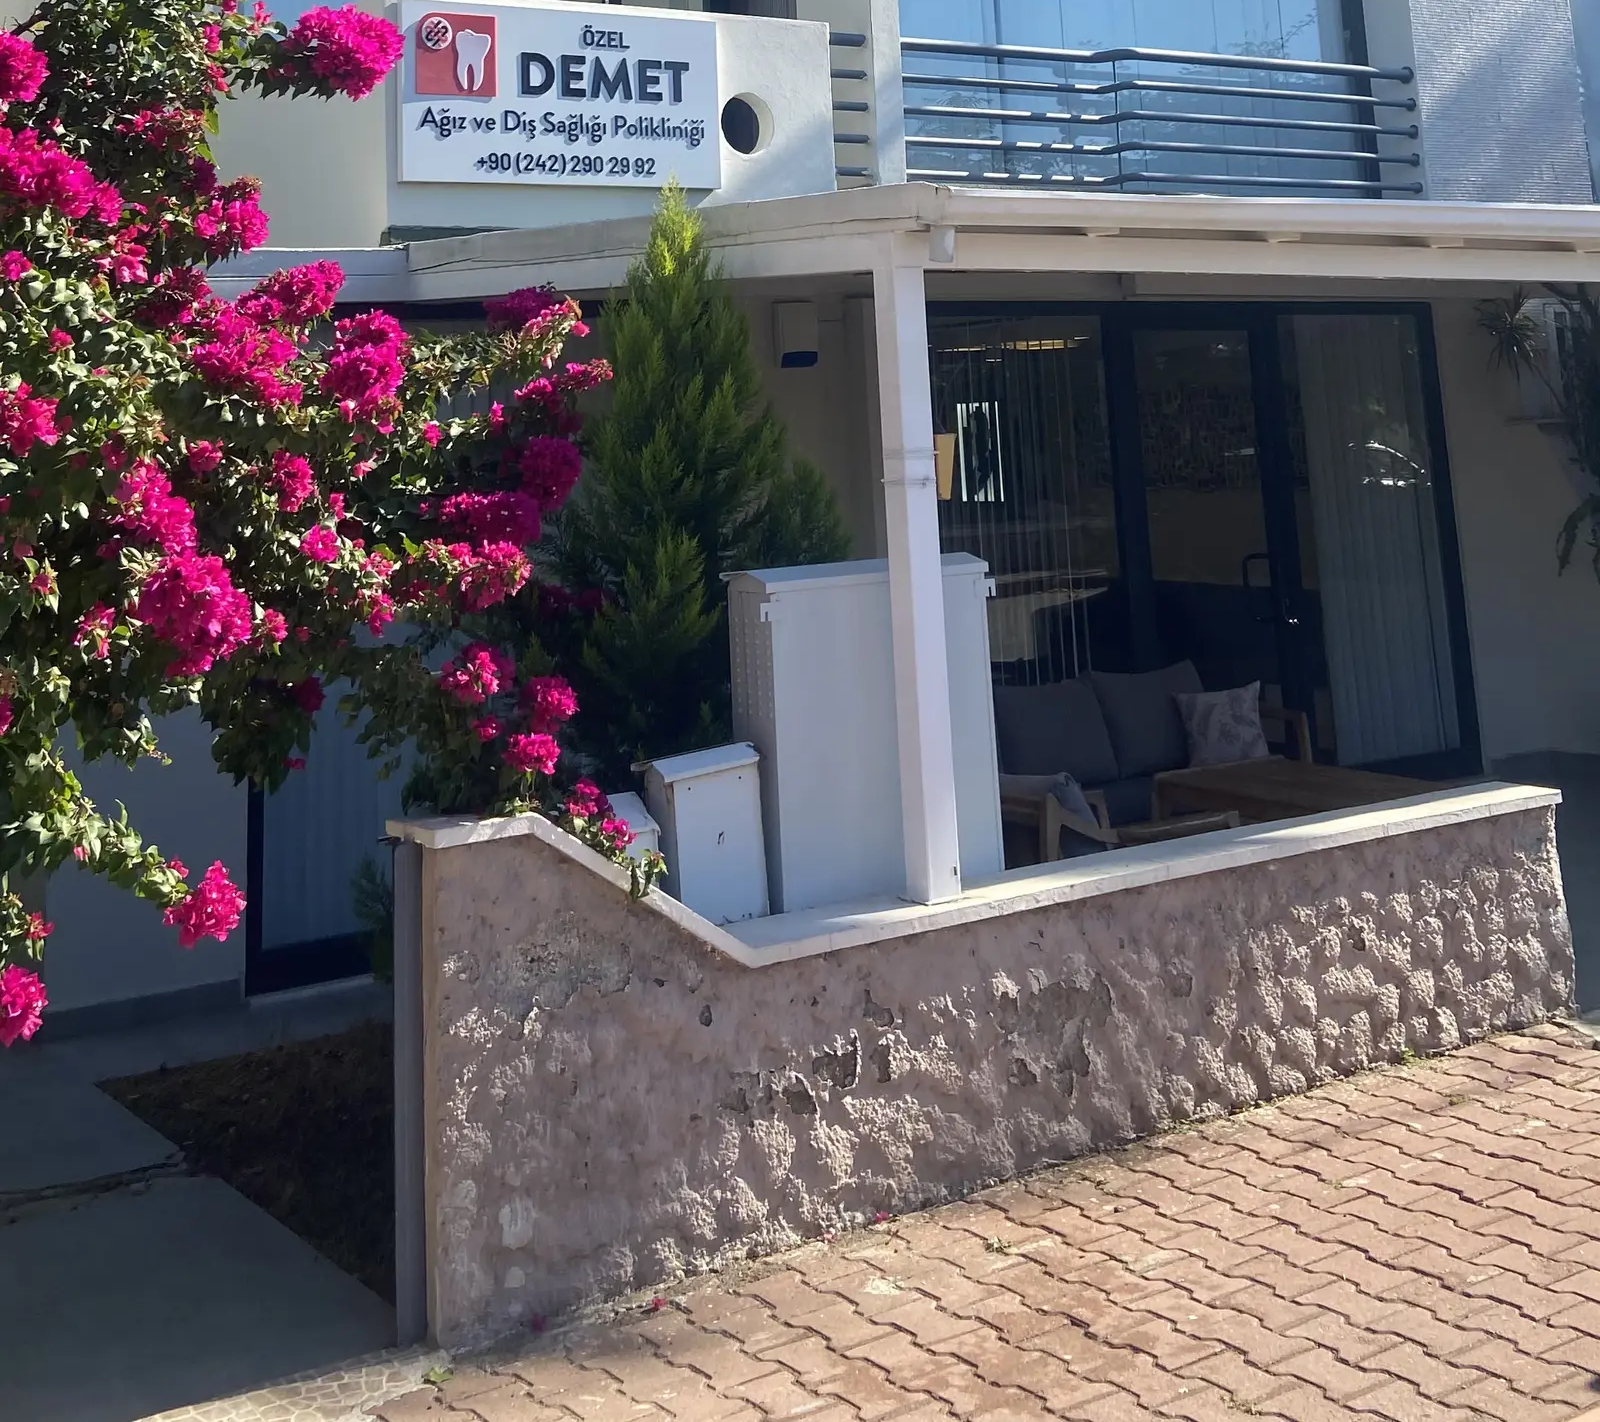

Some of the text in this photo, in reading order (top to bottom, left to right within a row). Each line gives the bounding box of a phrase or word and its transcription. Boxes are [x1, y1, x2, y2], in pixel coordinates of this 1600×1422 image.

[582, 24, 631, 49] ÖZEL
[519, 51, 690, 104] DEMET
[420, 106, 705, 147] Ağız ve Diş Sağlığı Polikliniği
